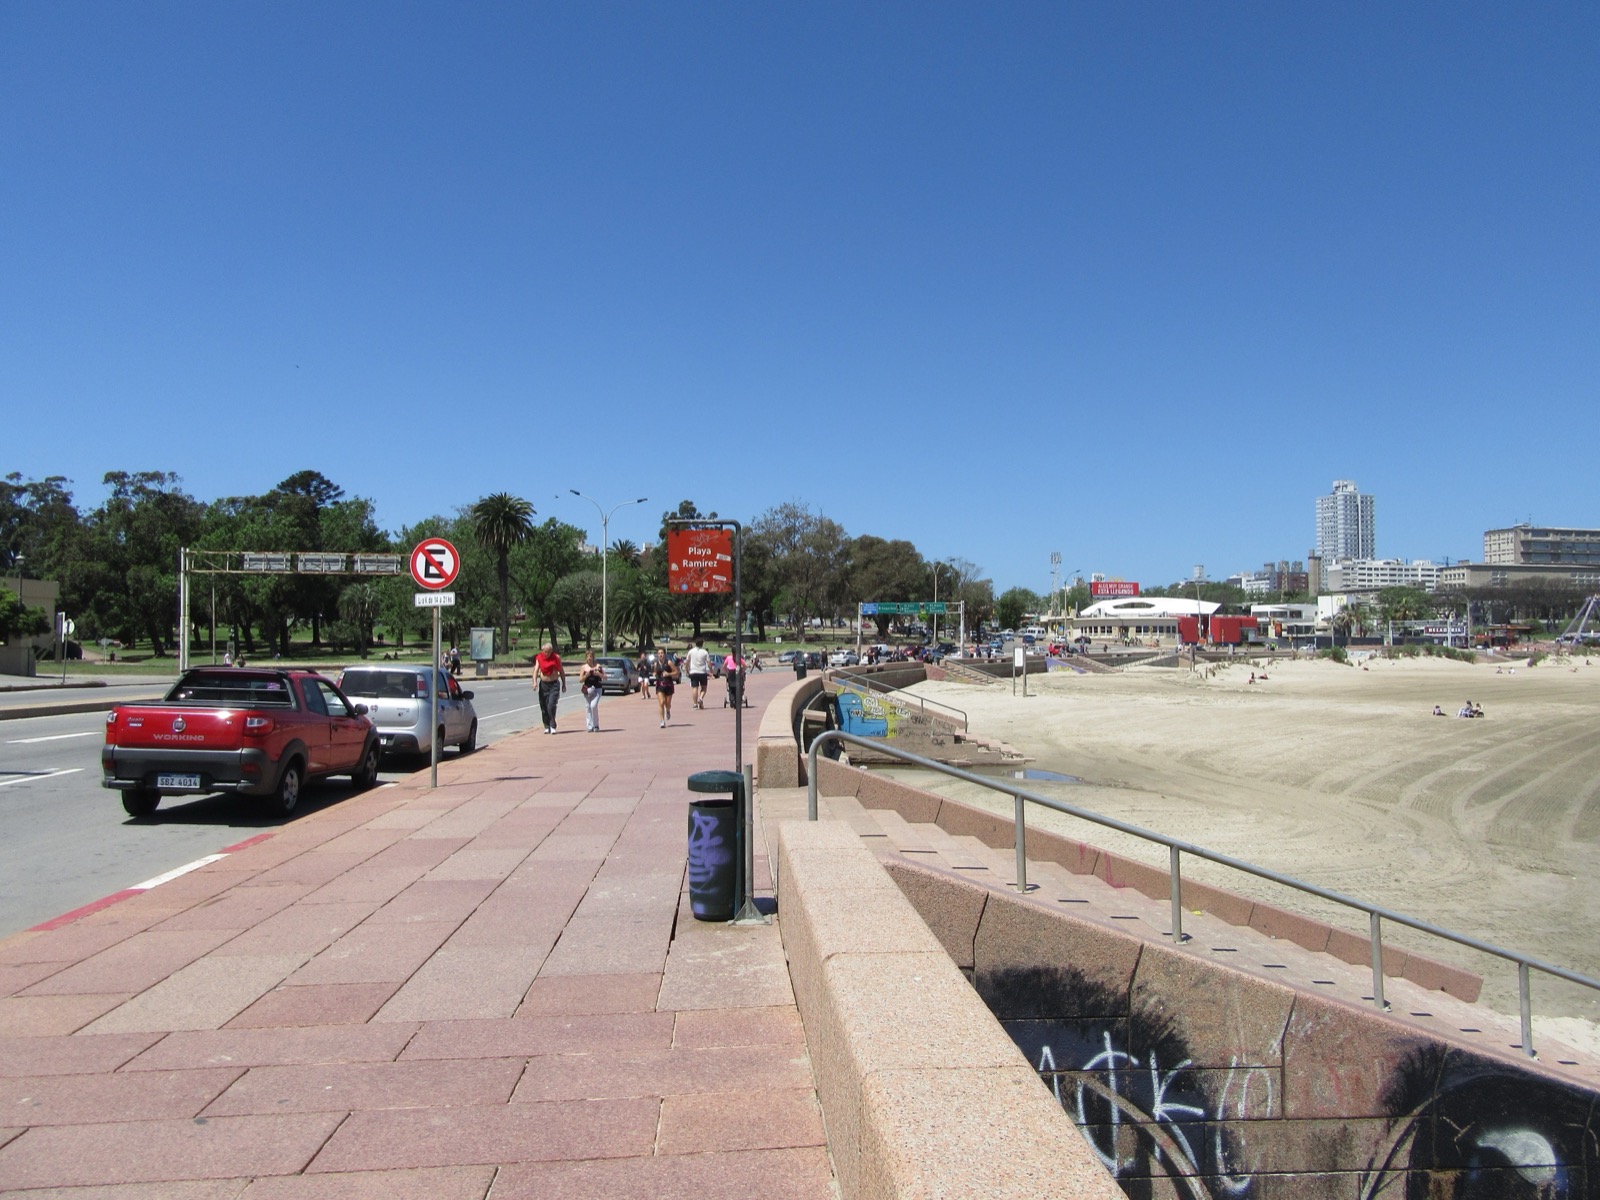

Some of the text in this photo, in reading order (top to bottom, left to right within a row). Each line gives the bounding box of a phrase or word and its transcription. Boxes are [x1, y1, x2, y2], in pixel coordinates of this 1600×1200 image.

[688, 546, 712, 557] Playa
[424, 549, 446, 578] E
[682, 558, 718, 568] Ramírez
[153, 733, 205, 742] WORKING
[160, 777, 198, 786] SBZ 4014
